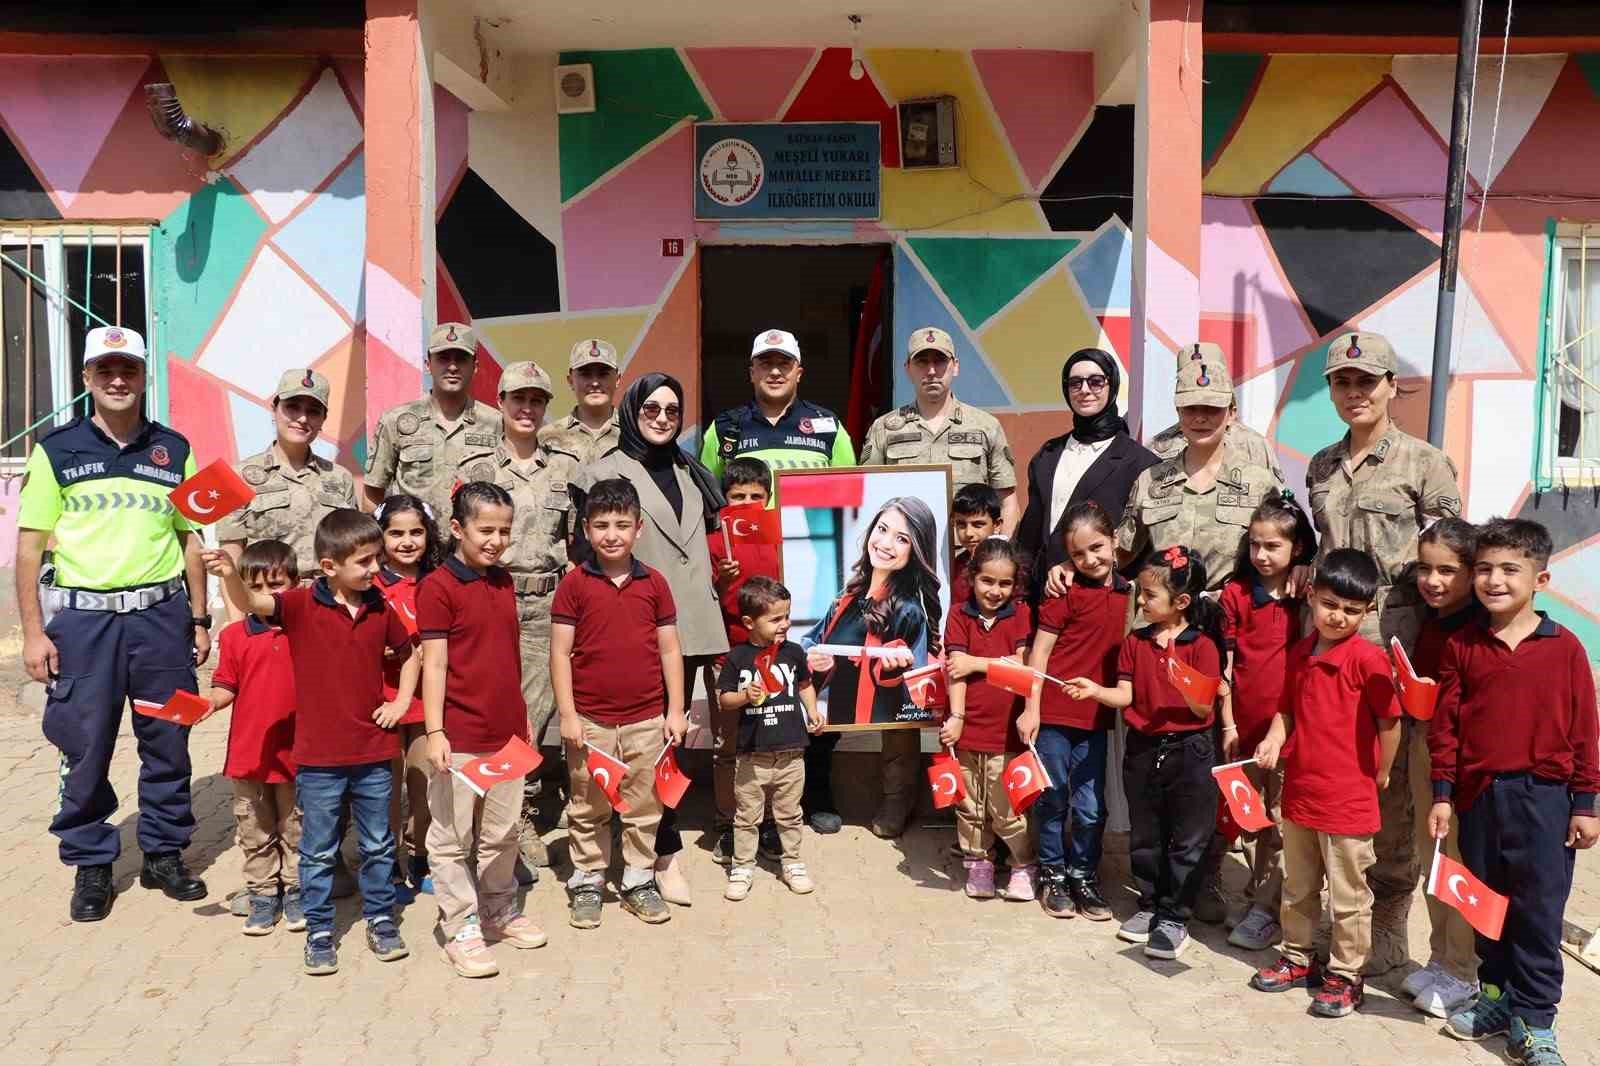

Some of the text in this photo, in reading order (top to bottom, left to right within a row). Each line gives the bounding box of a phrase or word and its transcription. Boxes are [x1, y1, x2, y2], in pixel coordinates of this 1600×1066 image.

[823, 150, 869, 162] YUKARI
[768, 169, 872, 183] MAHALLE MERKEZ
[838, 192, 876, 208] OKULU
[668, 242, 678, 254] 16
